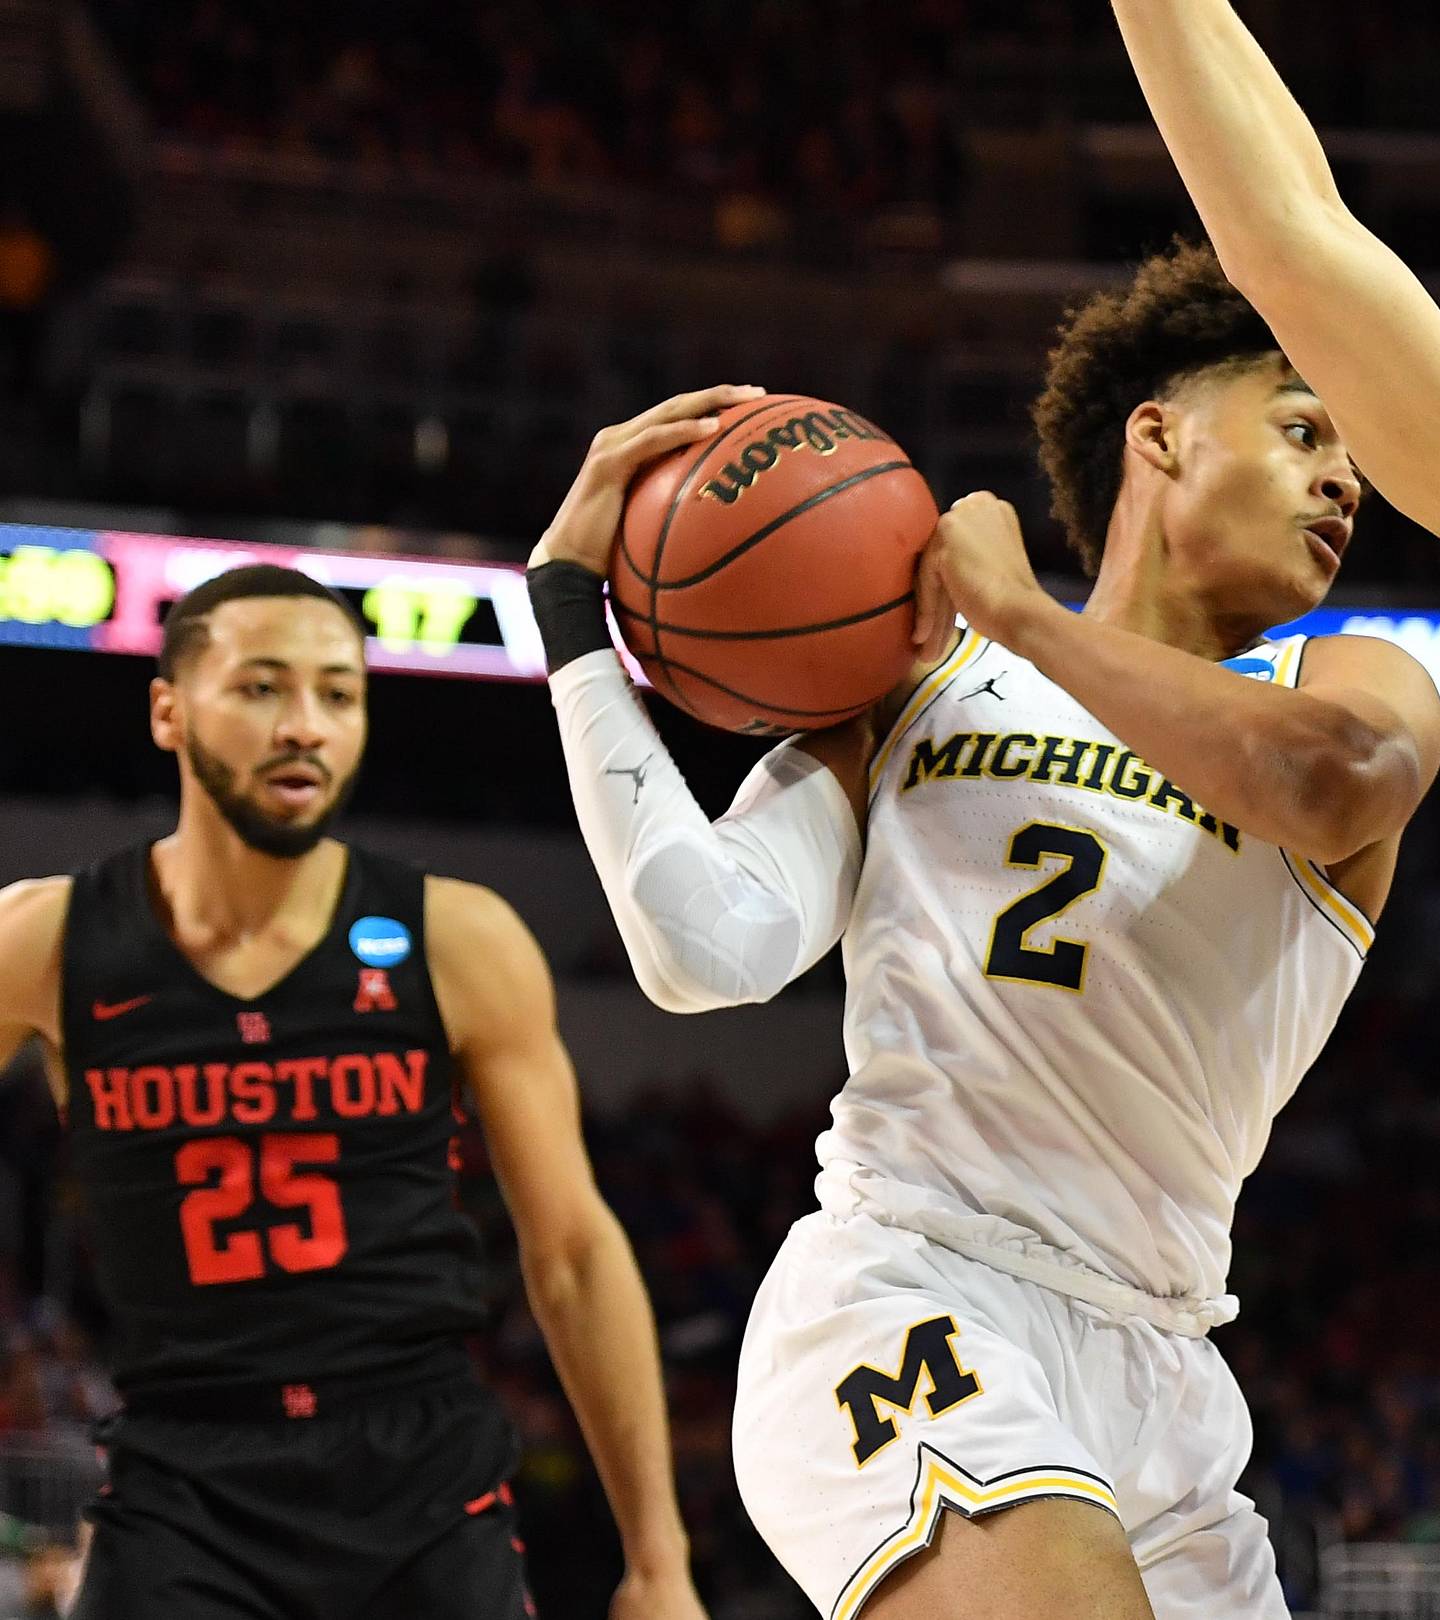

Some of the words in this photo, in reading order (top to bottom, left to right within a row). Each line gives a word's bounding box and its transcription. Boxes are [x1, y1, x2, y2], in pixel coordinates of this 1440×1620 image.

[981, 818, 1107, 994] 2
[85, 1049, 430, 1132] HOUSTON
[173, 1132, 351, 1287] 25
[834, 1313, 985, 1470] M
